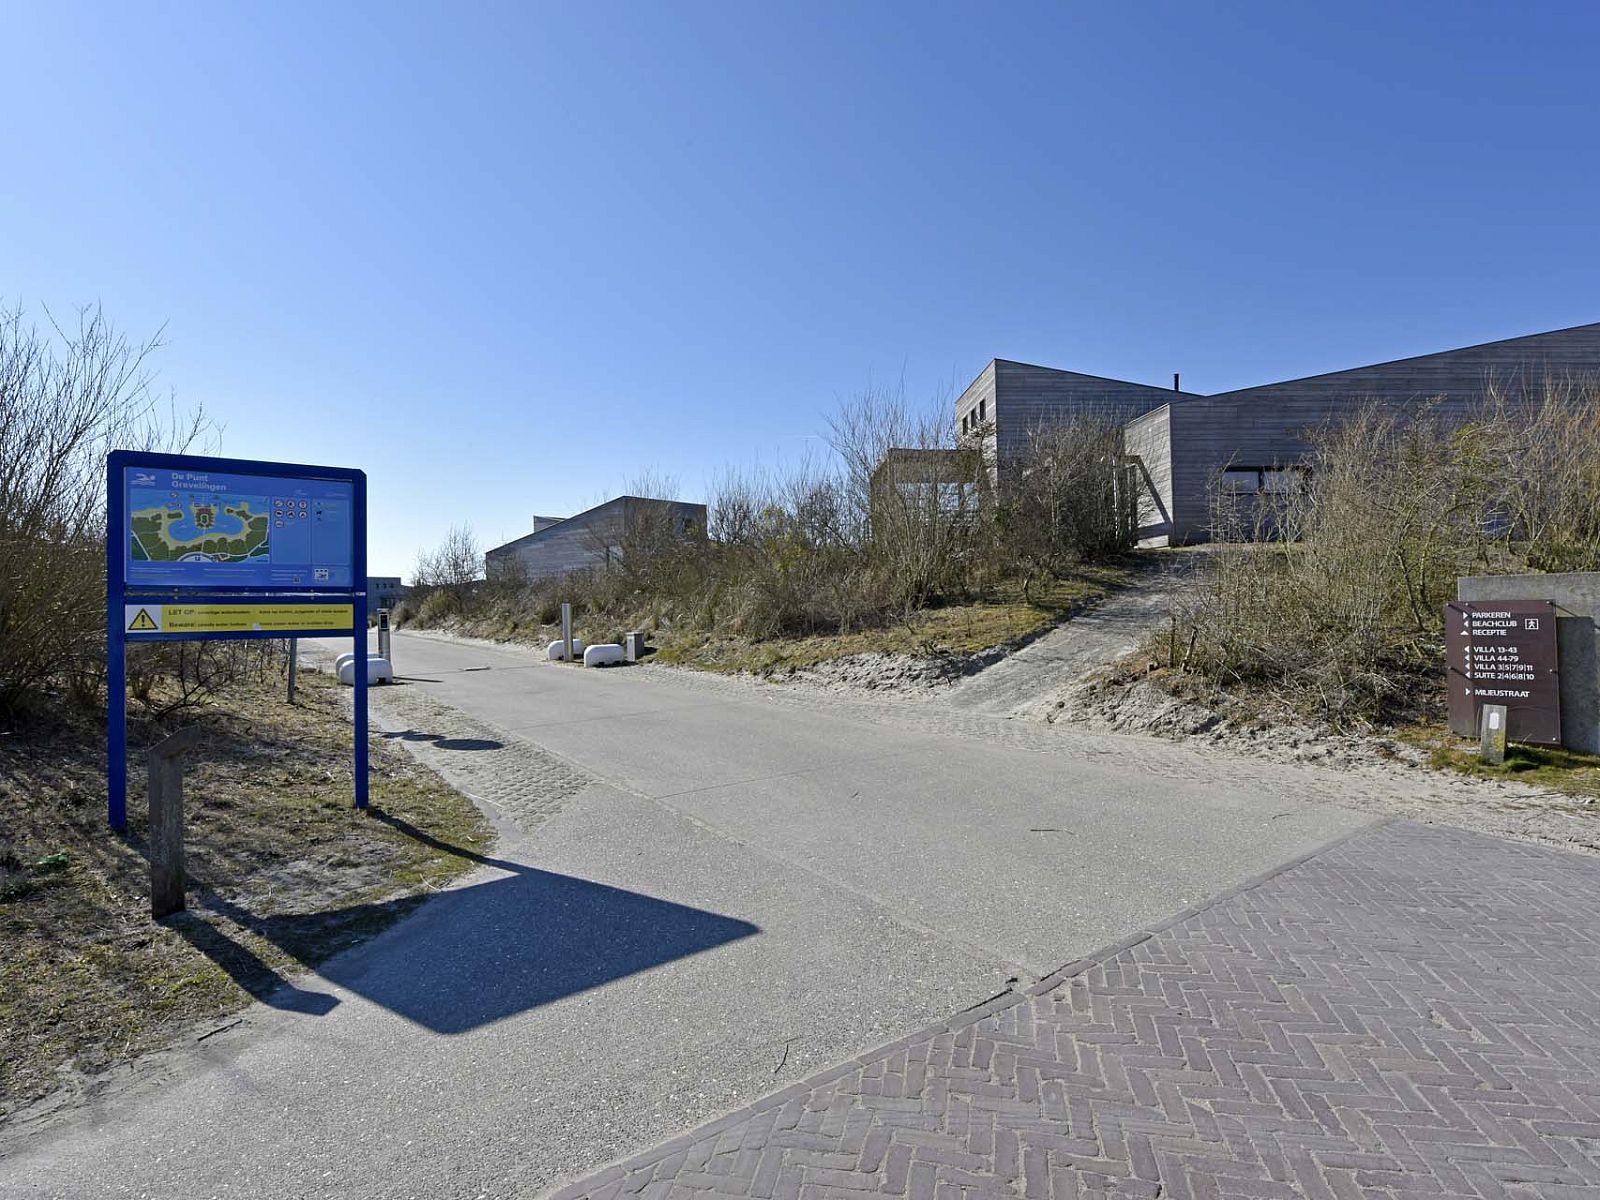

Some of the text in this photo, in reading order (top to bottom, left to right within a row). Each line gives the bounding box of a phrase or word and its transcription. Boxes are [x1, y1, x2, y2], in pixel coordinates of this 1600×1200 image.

[171, 472, 209, 482] De Punt
[1474, 663, 1496, 671] VILLA
